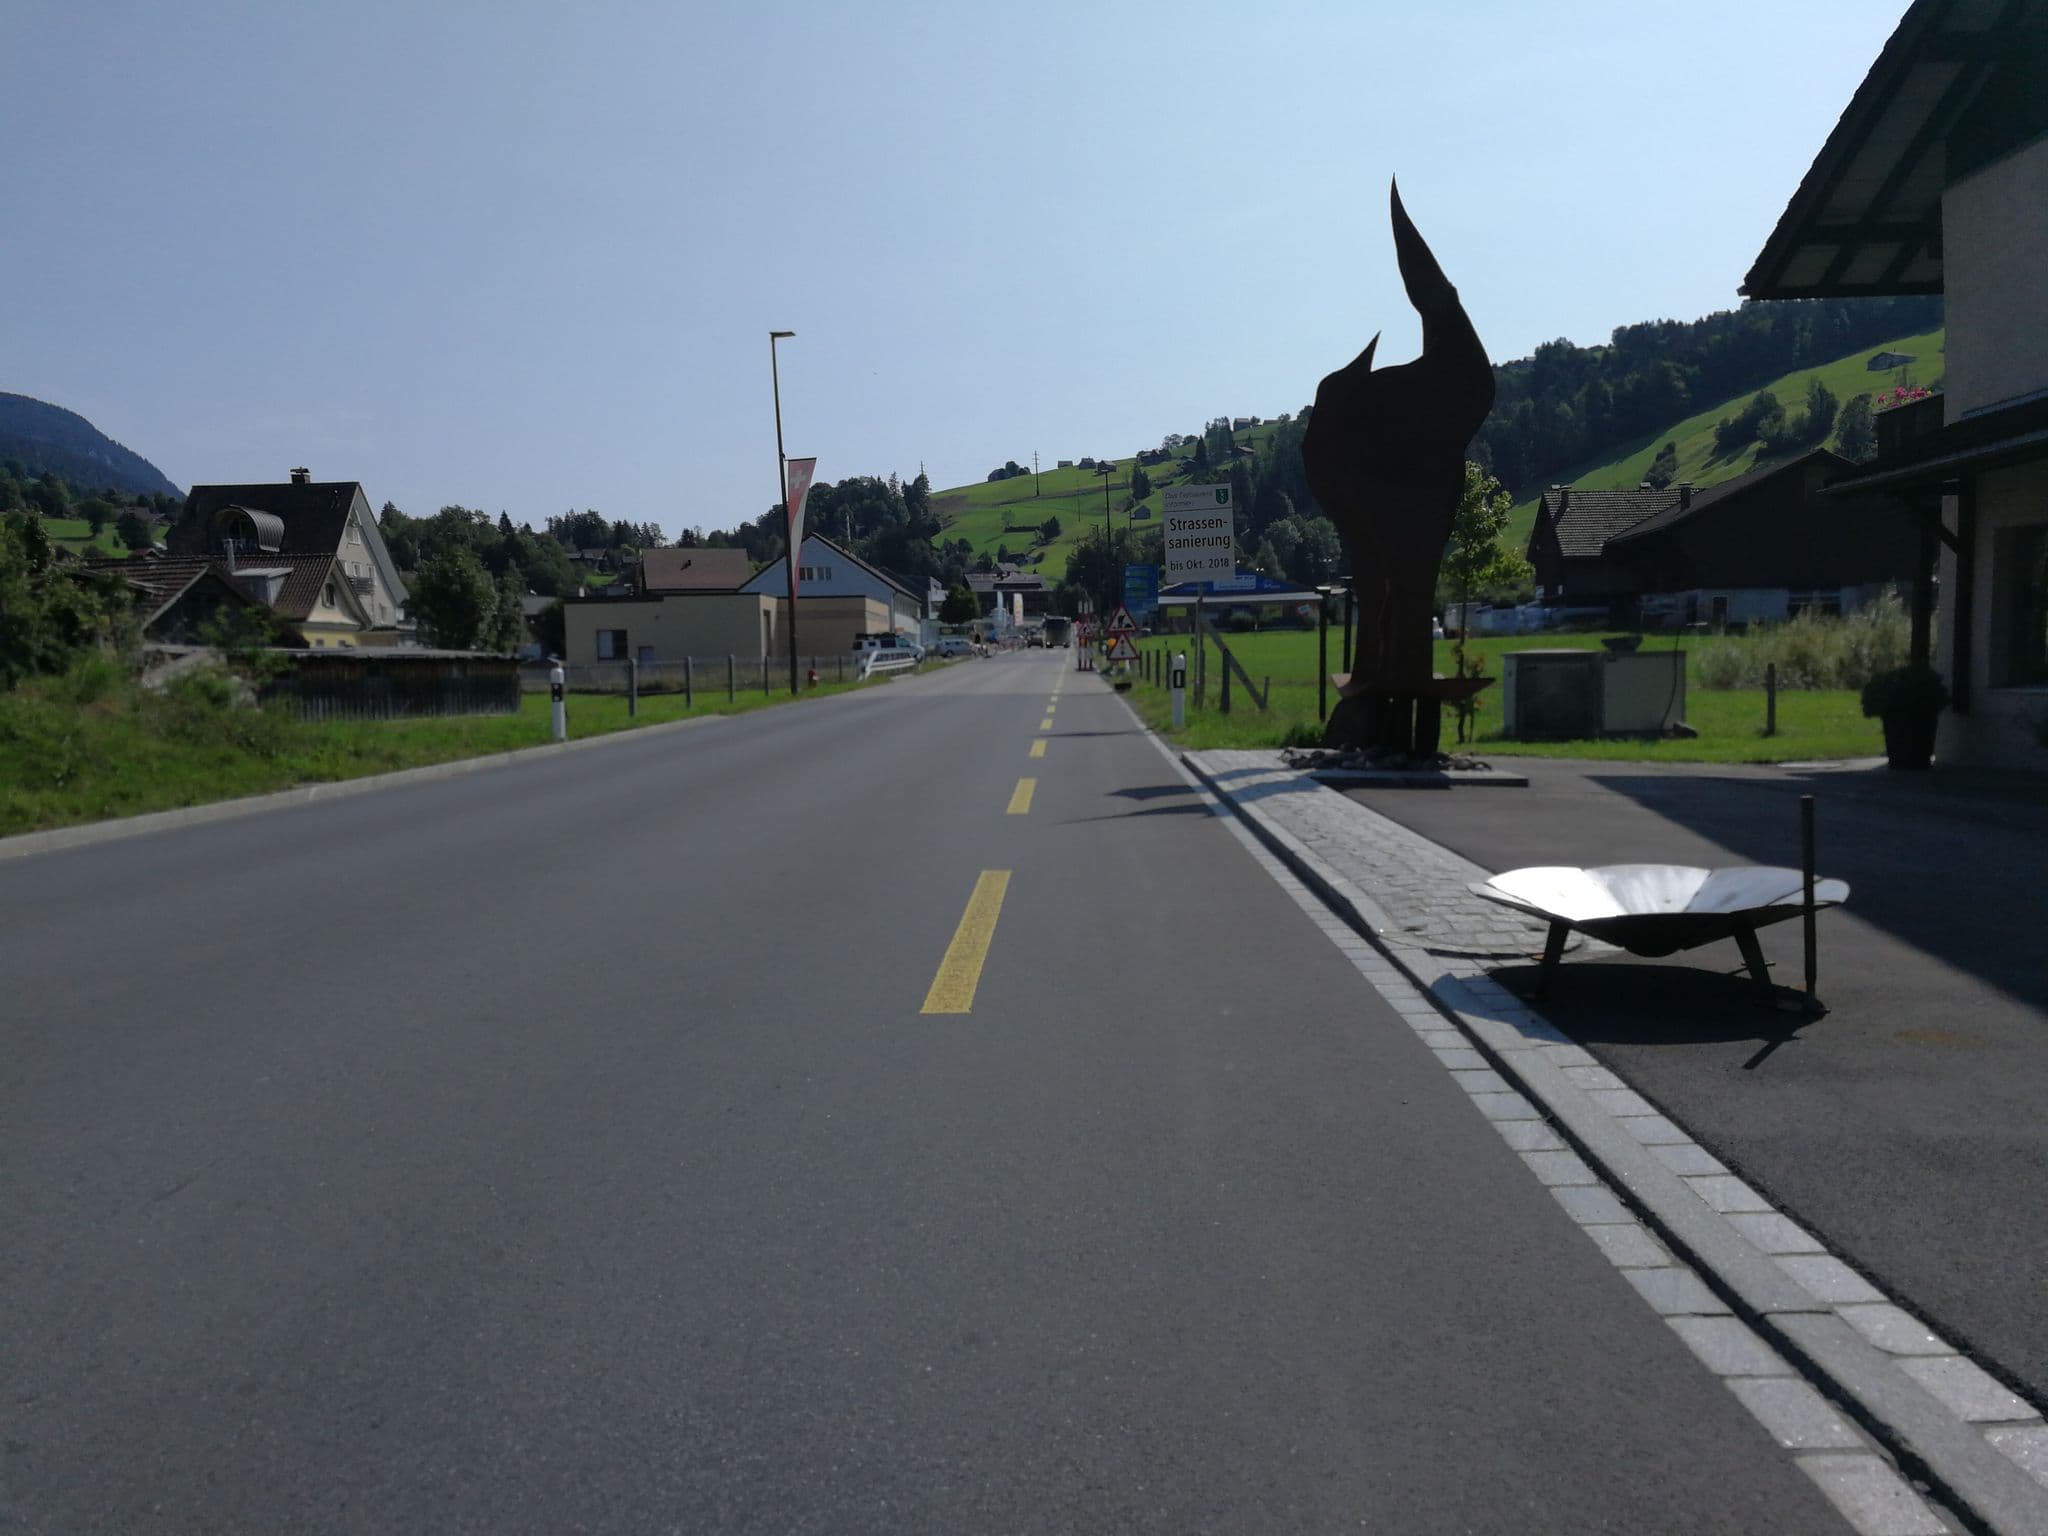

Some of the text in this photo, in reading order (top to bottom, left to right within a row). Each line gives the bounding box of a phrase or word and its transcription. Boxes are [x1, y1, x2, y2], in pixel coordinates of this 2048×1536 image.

[1169, 518, 1228, 531] Strassen-
[1168, 535, 1231, 549] sanierung
[1170, 558, 1229, 571] bis Okt. 2018
